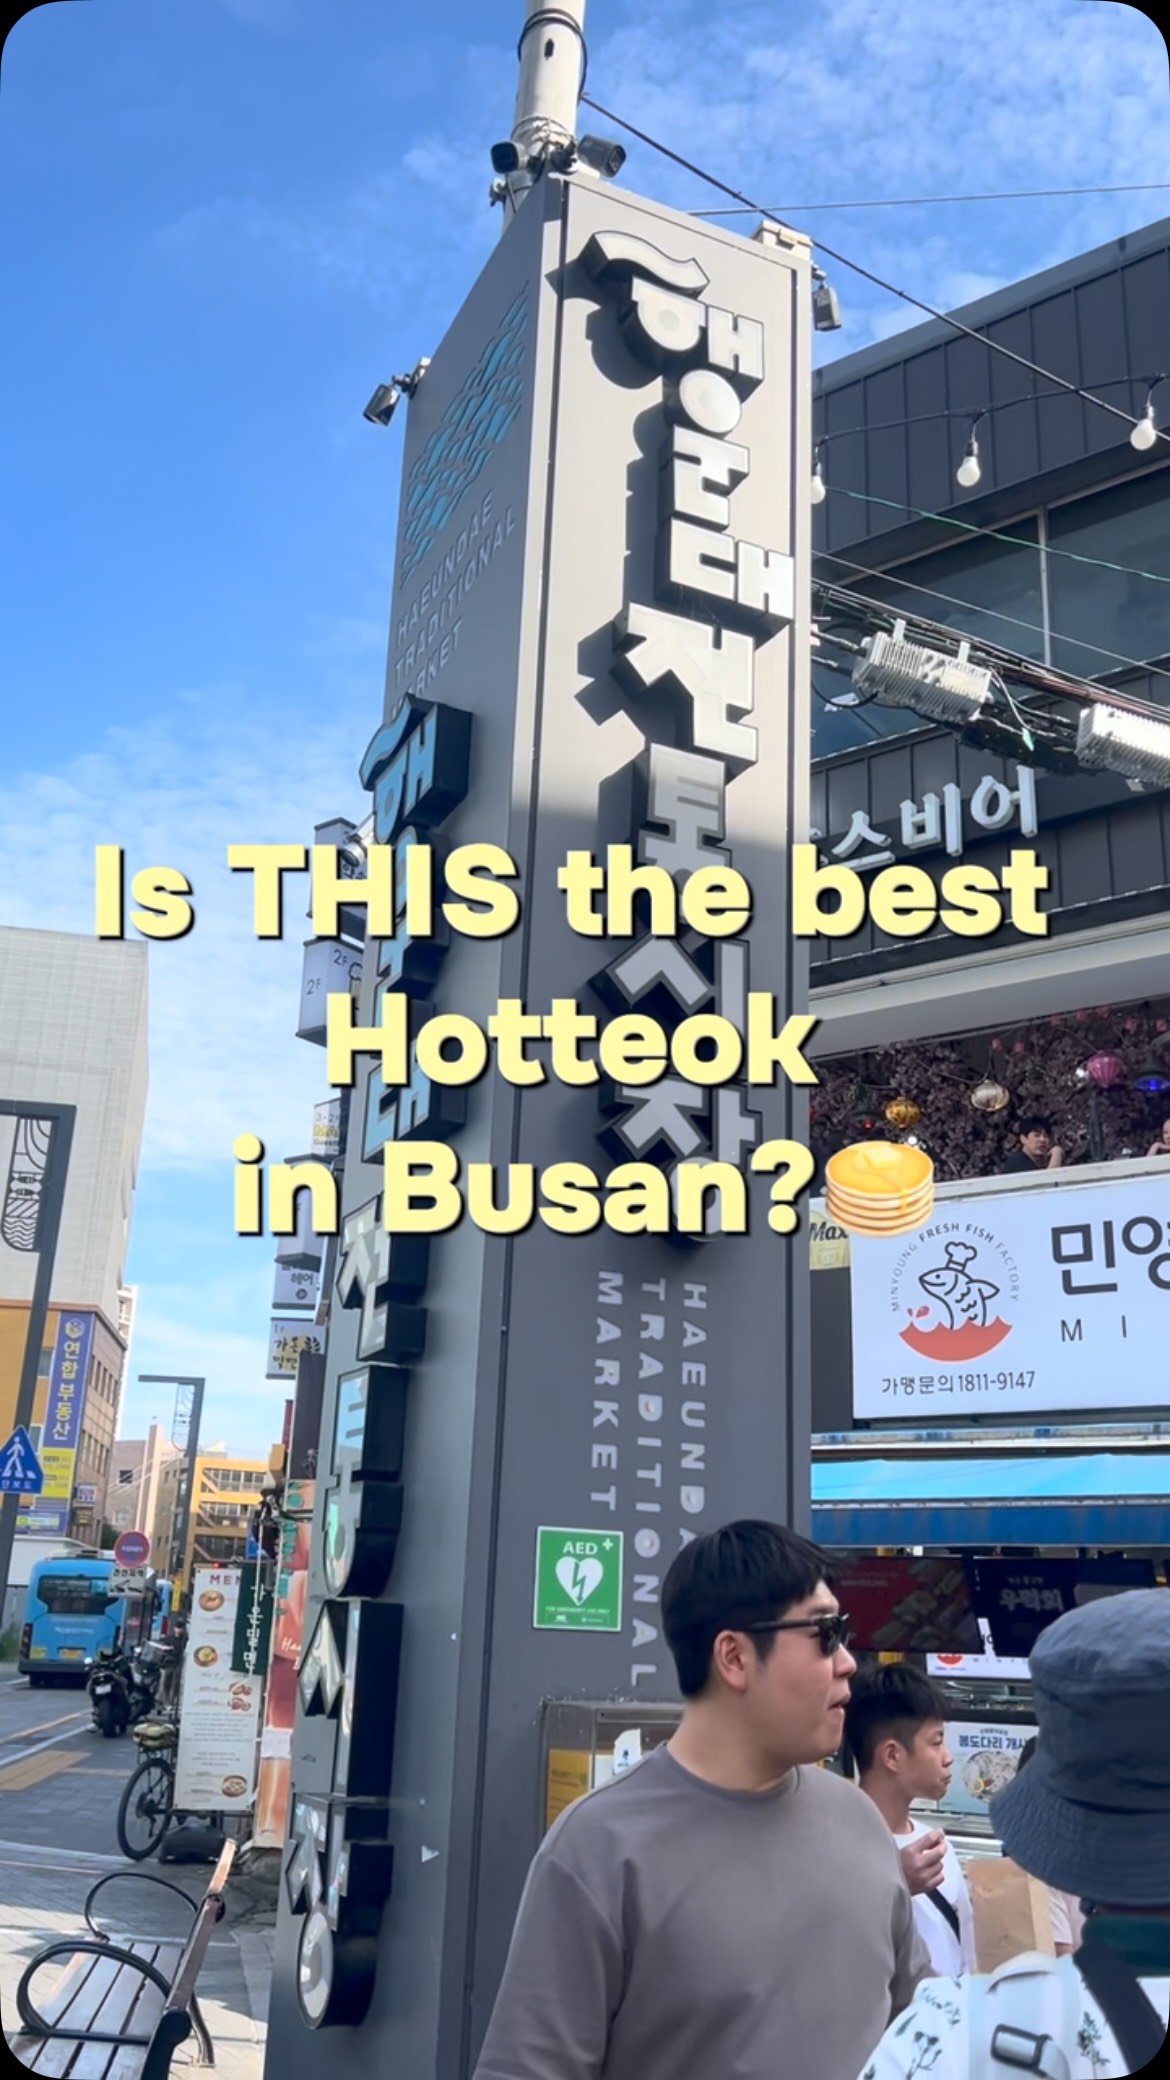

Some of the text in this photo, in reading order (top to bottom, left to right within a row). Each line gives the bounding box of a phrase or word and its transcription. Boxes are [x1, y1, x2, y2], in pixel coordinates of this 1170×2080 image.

[394, 505, 517, 686] TRADITIONAL
[397, 489, 493, 649] HAEUNDAE
[810, 765, 1038, 873] 스비어
[809, 1221, 849, 1242] Max
[891, 1222, 1021, 1313] MINYOUNG FRESH FISH FACTORY
[590, 1270, 624, 1511] MARKET
[678, 1282, 708, 1551] HAEUNDA
[881, 1370, 1036, 1396] 가맹문의 1811-9147
[1, 1479, 33, 1490] 단보도
[631, 1276, 666, 1687] TRADITIONAL
[209, 1574, 241, 1585] MEN
[562, 1540, 598, 1555] AED
